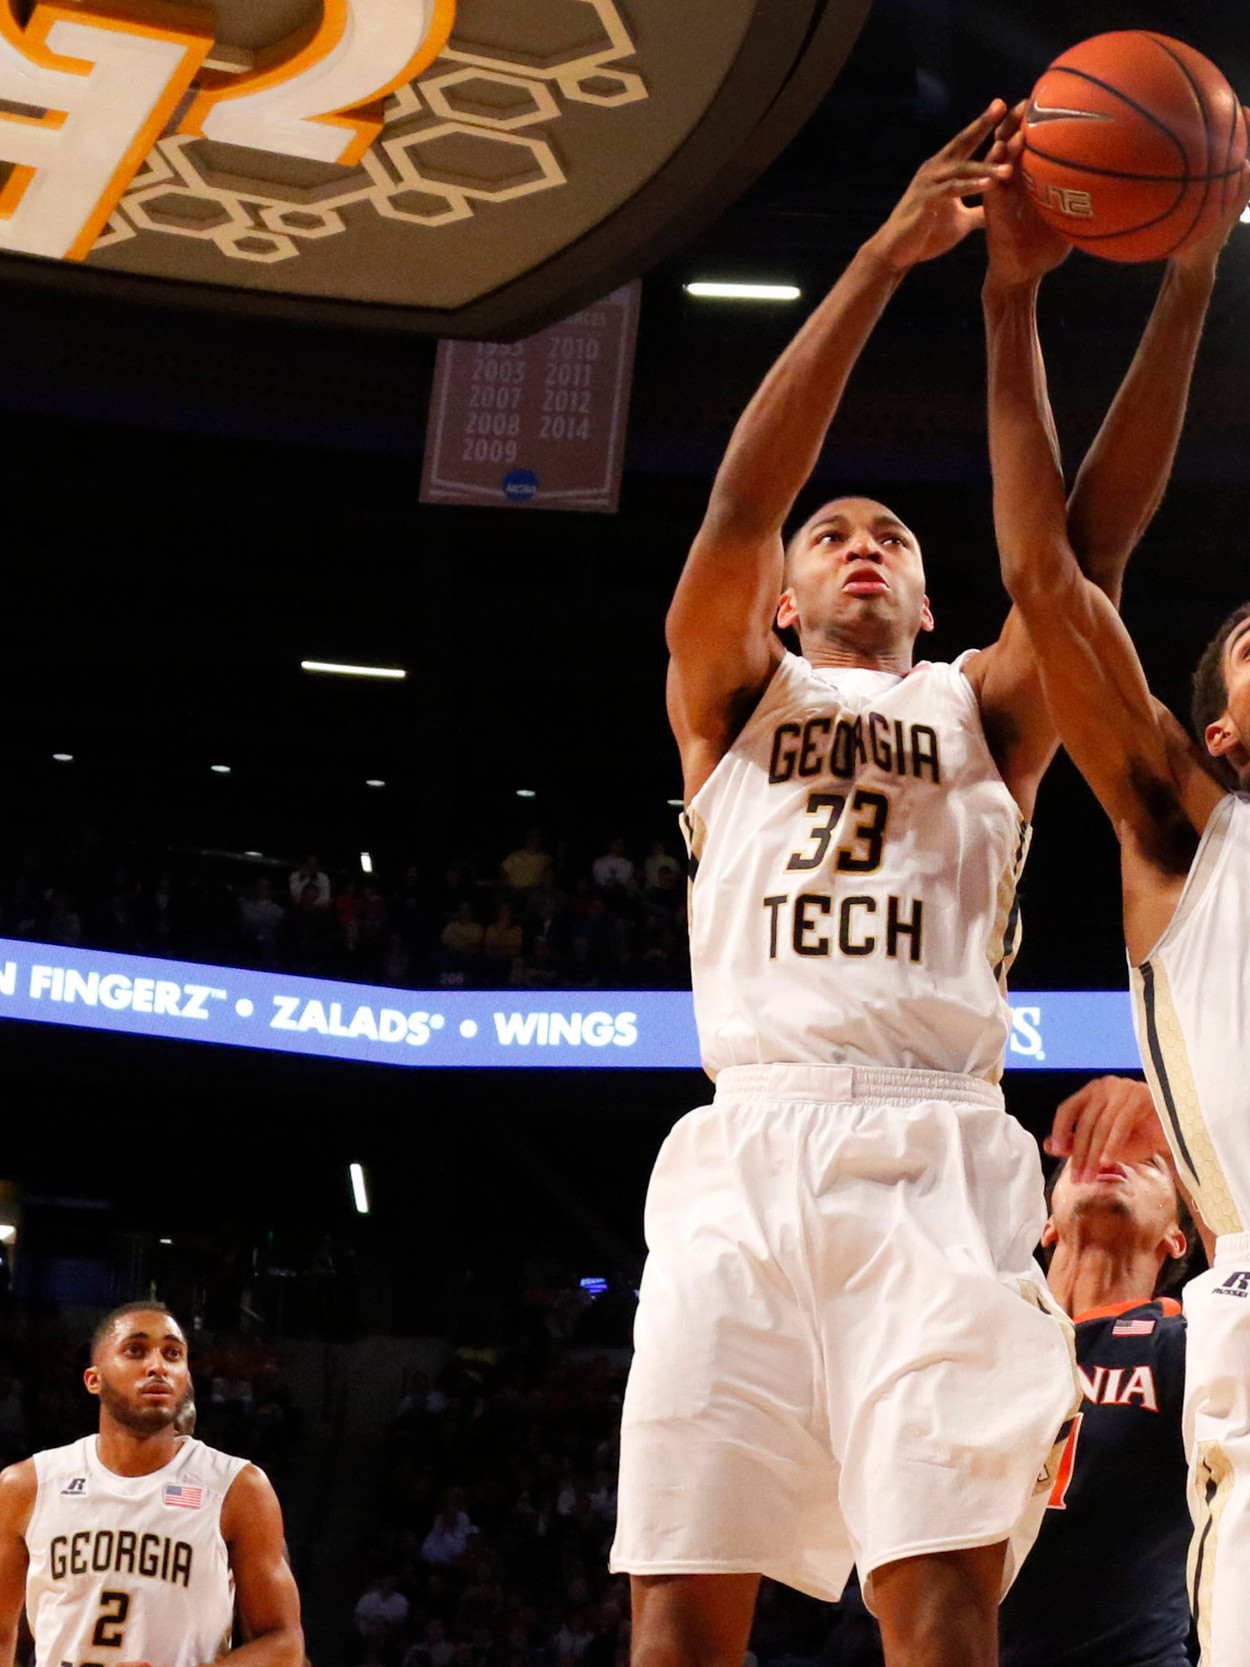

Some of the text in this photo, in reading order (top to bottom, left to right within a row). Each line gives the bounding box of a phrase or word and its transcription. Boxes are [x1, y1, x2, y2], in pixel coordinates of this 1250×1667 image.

[549, 337, 600, 360] 2010
[471, 359, 526, 384] 2003
[545, 363, 592, 386] 2011
[468, 385, 522, 409] 2007
[542, 390, 591, 414] 2012
[465, 412, 520, 436] 2008
[539, 416, 589, 440] 2014
[462, 437, 517, 463] 2009
[768, 711, 940, 785] GEORGIA
[783, 787, 891, 876] 33
[763, 893, 924, 964] TECH
[493, 1011, 638, 1046] WINGS
[49, 1530, 194, 1588] GEORGIA
[92, 1589, 130, 1648] 2
